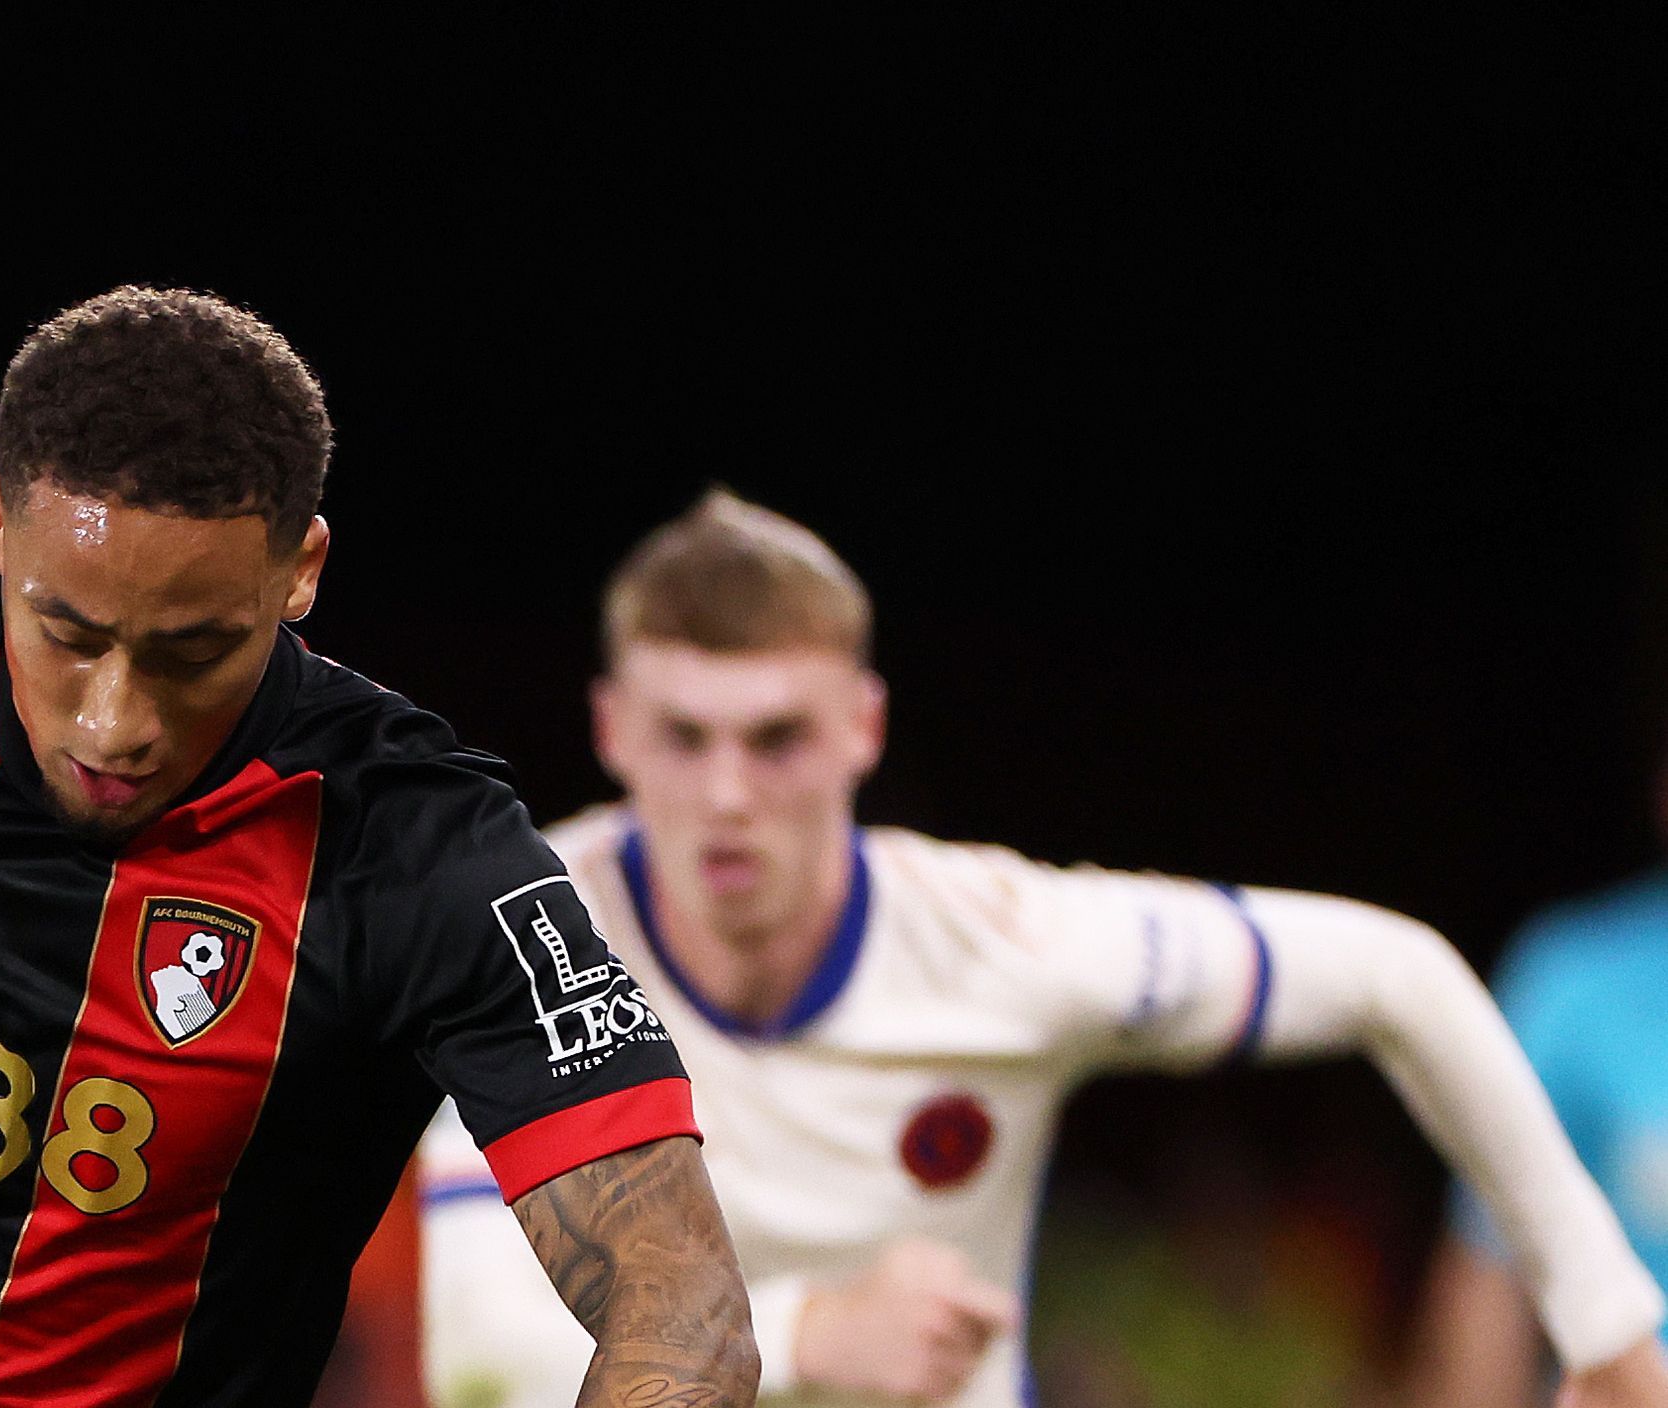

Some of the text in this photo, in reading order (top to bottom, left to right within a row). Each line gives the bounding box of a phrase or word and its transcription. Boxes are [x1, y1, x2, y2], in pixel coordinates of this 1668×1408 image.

[152, 907, 250, 937] AFC BOURNEMOUTH
[551, 1030, 672, 1079] INTERTIONA
